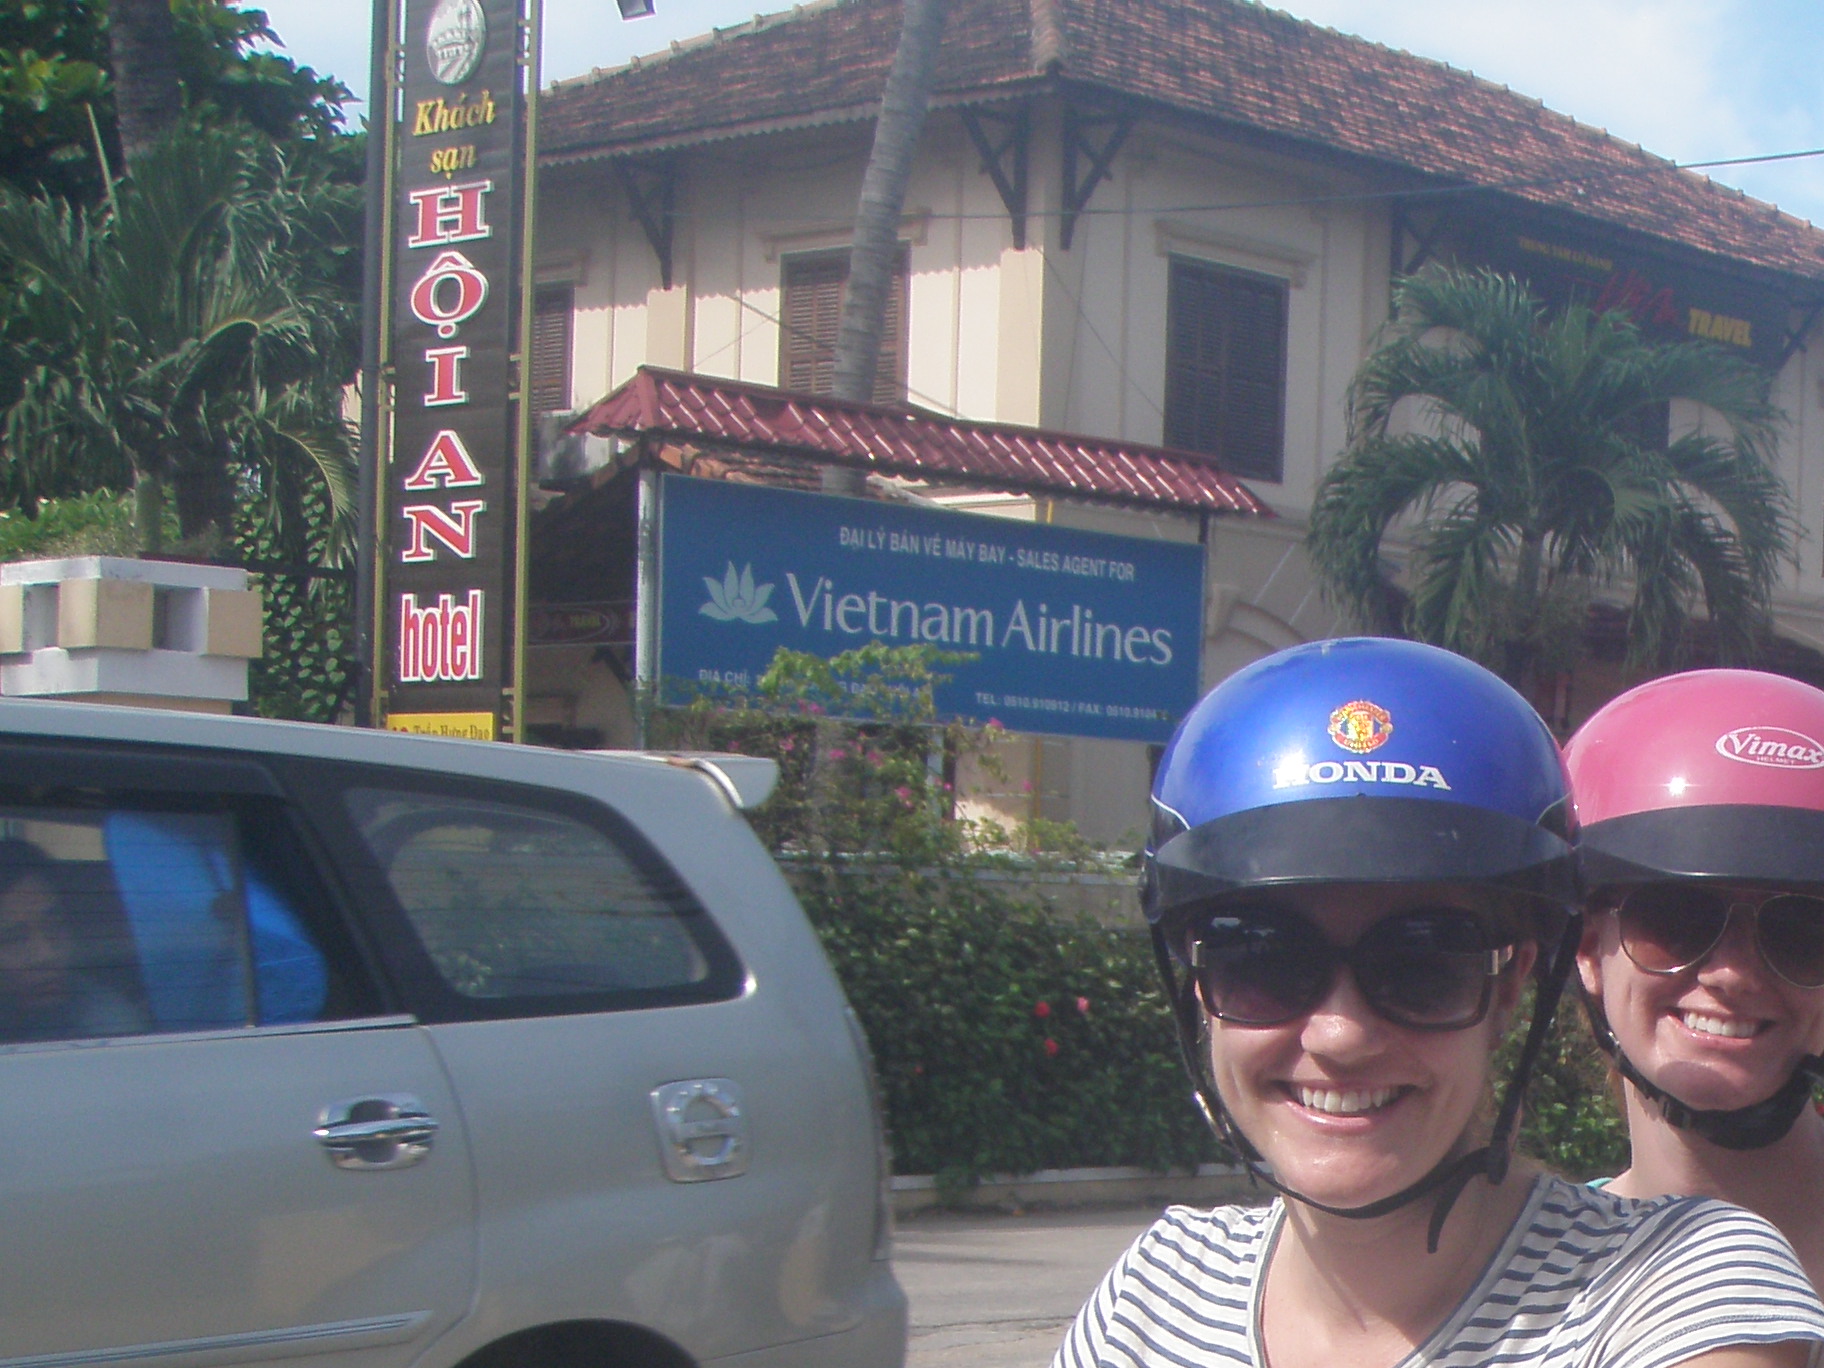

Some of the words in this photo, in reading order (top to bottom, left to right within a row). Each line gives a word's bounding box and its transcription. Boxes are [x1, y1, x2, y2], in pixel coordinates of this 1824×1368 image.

[412, 89, 496, 137] Khách
[429, 143, 477, 179] sạn
[840, 526, 865, 549] ĐẠI
[867, 525, 885, 549] LÝ
[890, 529, 919, 554] BÁN
[947, 534, 974, 560] MÁY
[978, 543, 1006, 565] BAY
[1017, 549, 1059, 572] SALES
[1062, 555, 1106, 578] AGENT
[1109, 561, 1135, 582] FOR
[400, 589, 485, 683] hotel
[786, 572, 993, 648] Vietnam
[1002, 598, 1172, 666] Airlines
[1729, 733, 1822, 763] Vimax
